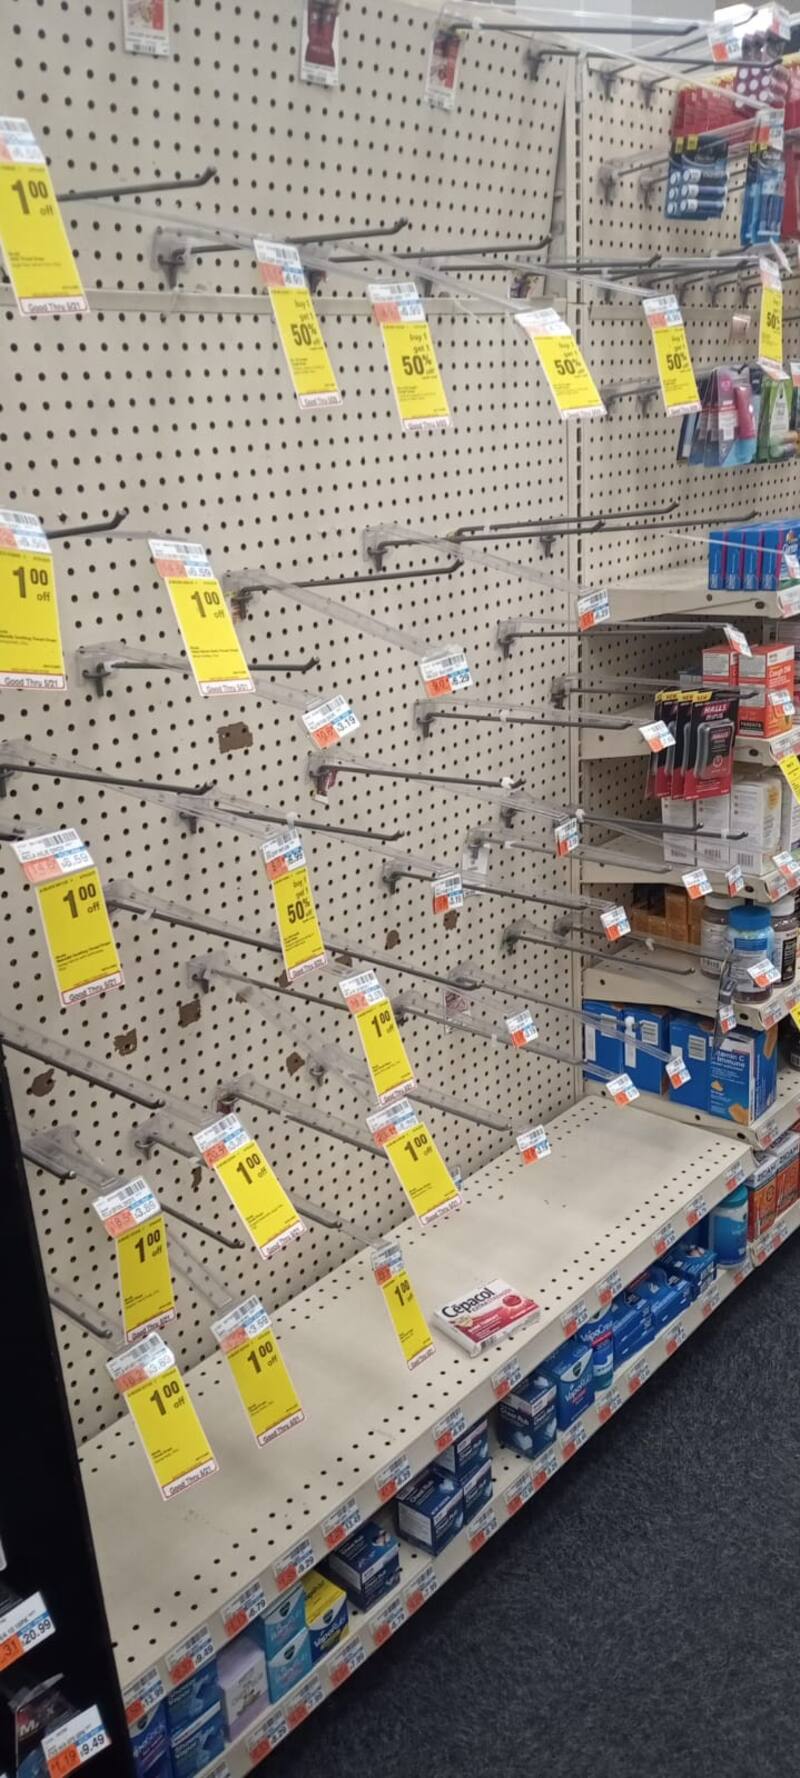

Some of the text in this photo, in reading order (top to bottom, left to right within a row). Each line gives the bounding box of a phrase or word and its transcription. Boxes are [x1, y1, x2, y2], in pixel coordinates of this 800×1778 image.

[36, 591, 50, 602] off
[213, 608, 226, 619] off
[704, 703, 728, 715] HALLS
[336, 716, 356, 732] 3.19
[87, 901, 101, 914] off
[716, 1055, 746, 1068] Immune
[266, 1354, 278, 1368] off
[173, 1396, 186, 1409] off
